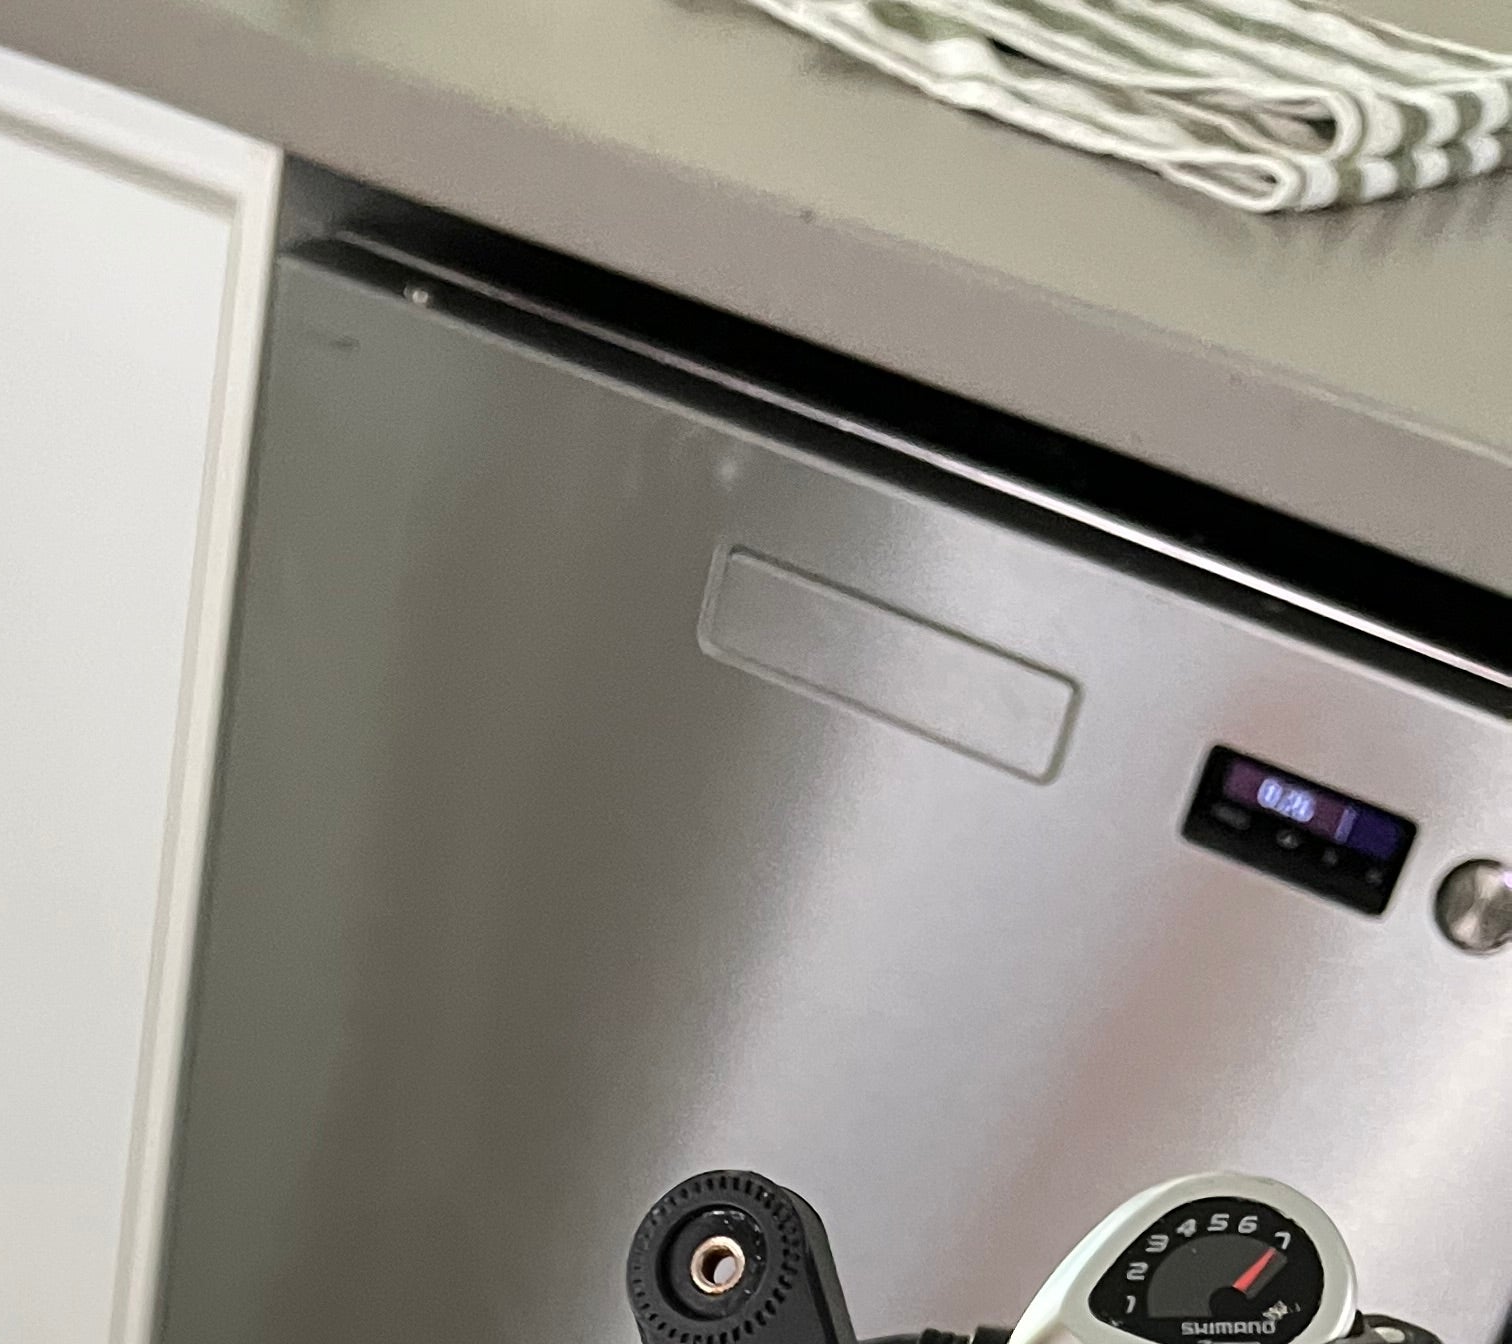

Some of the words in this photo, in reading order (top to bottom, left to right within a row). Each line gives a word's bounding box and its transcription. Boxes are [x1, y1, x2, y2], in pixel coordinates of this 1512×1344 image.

[1176, 1218, 1197, 1238] 4
[1207, 1213, 1230, 1232] 5
[1238, 1215, 1258, 1234] 6
[1145, 1234, 1170, 1253] 3
[1274, 1231, 1291, 1250] 7
[1126, 1262, 1149, 1281] 2
[1126, 1296, 1136, 1314] 1
[1181, 1319, 1276, 1336] SHIMANO
